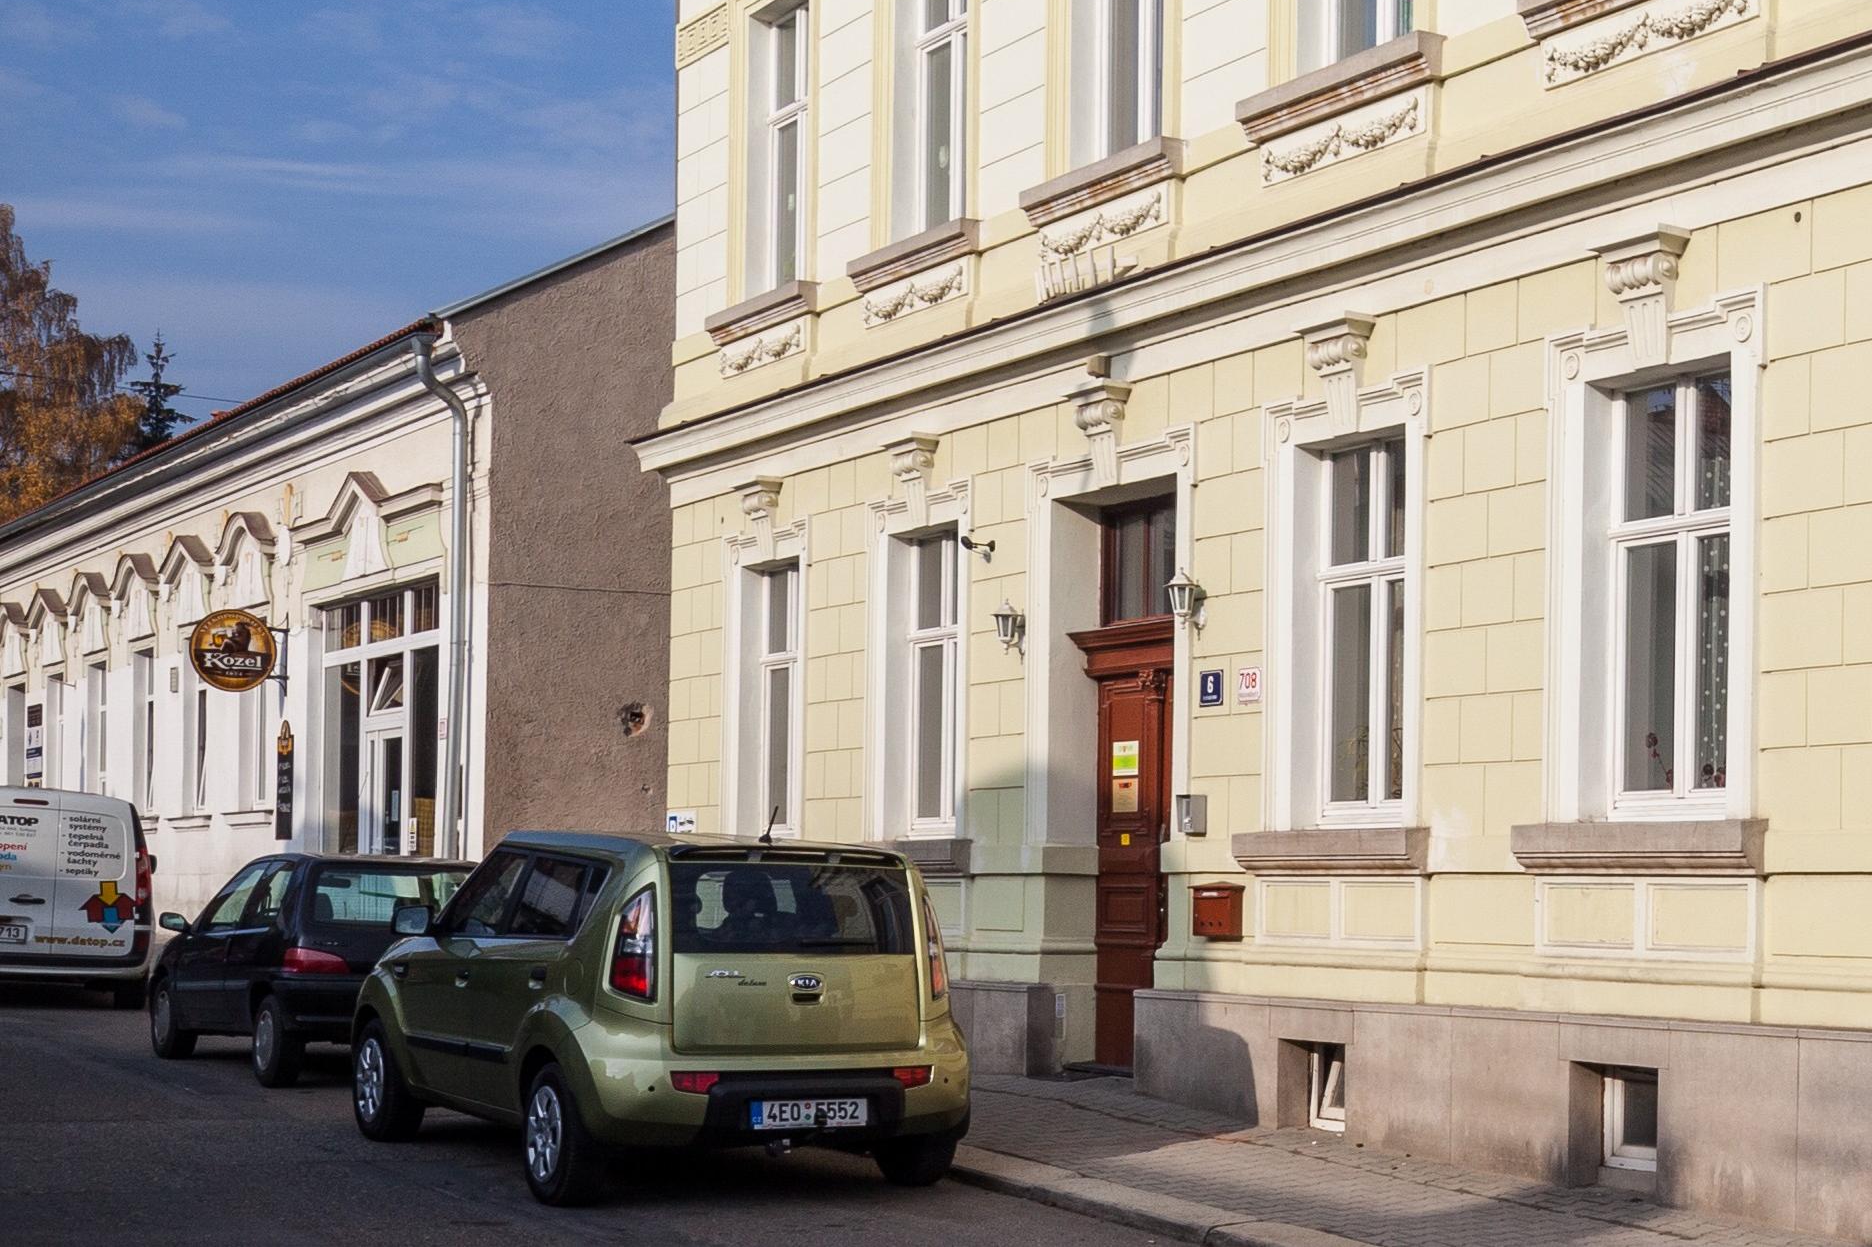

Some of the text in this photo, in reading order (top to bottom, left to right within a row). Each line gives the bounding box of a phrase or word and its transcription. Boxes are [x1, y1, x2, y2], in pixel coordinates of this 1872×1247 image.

[204, 652, 262, 671] Kozel
[1207, 675, 1214, 693] 6
[1239, 672, 1257, 690] 708
[65, 866, 99, 877] septiky
[34, 935, 126, 948] www.datop.cz
